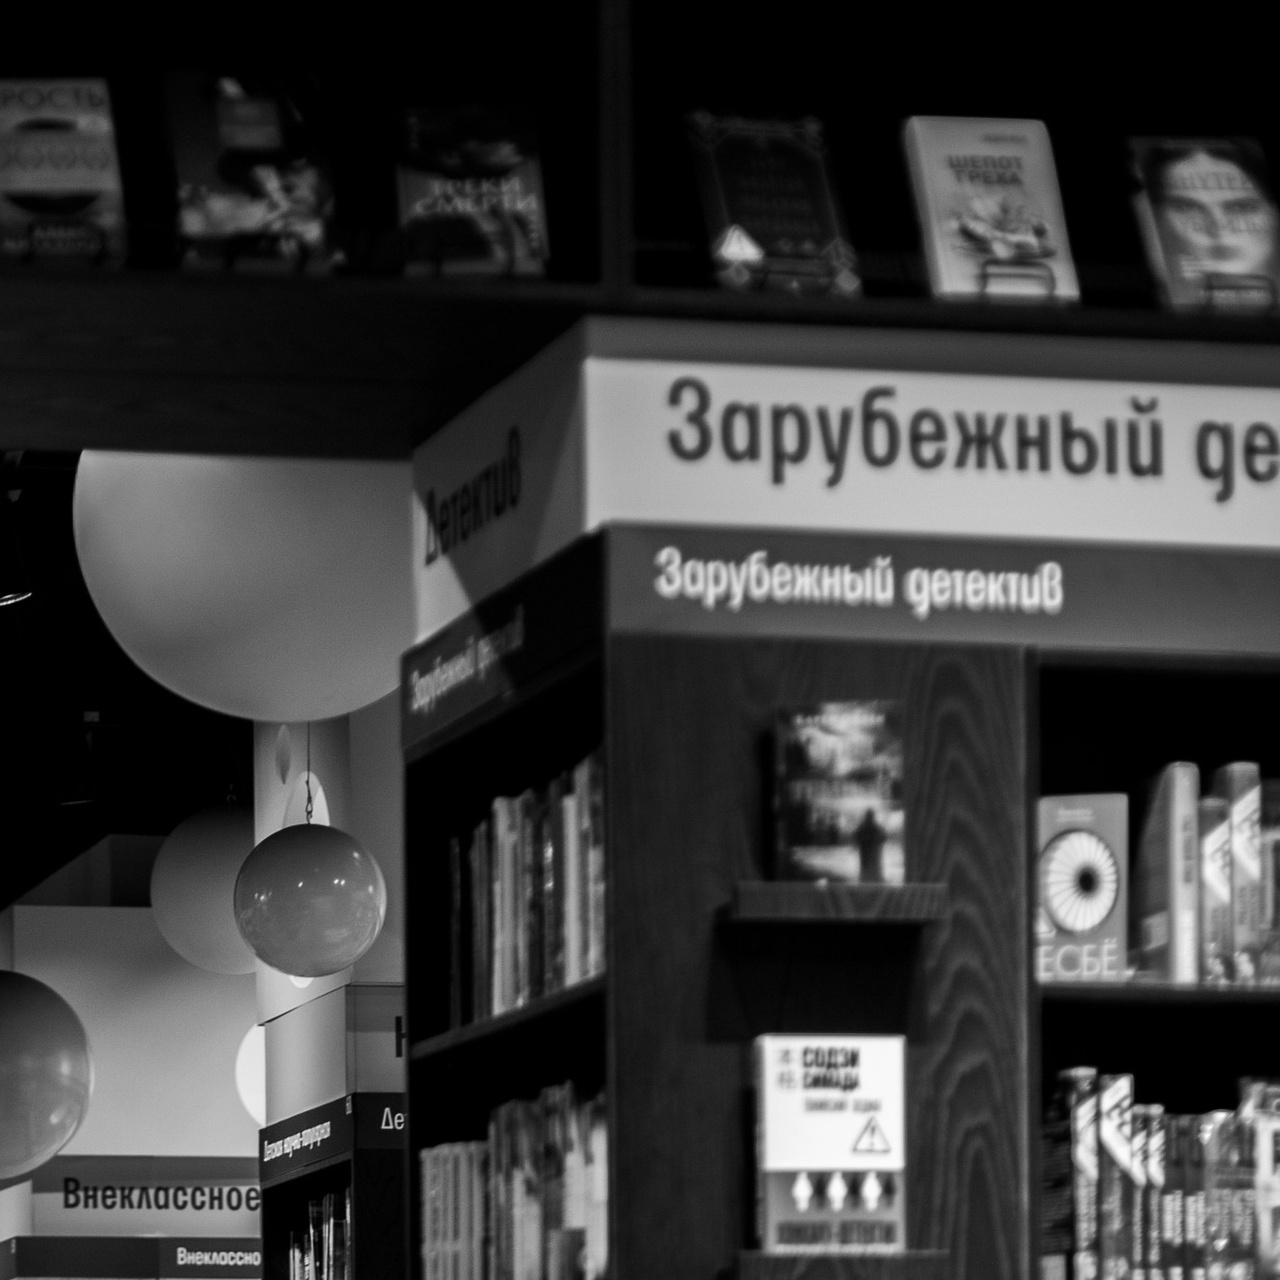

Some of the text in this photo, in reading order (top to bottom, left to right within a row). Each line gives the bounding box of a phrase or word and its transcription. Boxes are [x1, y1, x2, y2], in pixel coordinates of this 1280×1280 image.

[947, 154, 1023, 171] ШЕПОТ
[954, 170, 1023, 186] ГРЕХА
[666, 375, 1165, 489] Зарубежный
[424, 424, 520, 567] Детектив
[654, 545, 1065, 622] Зарубежный детектив
[380, 1107, 407, 1130] Де
[63, 1176, 261, 1212] Внеклассное
